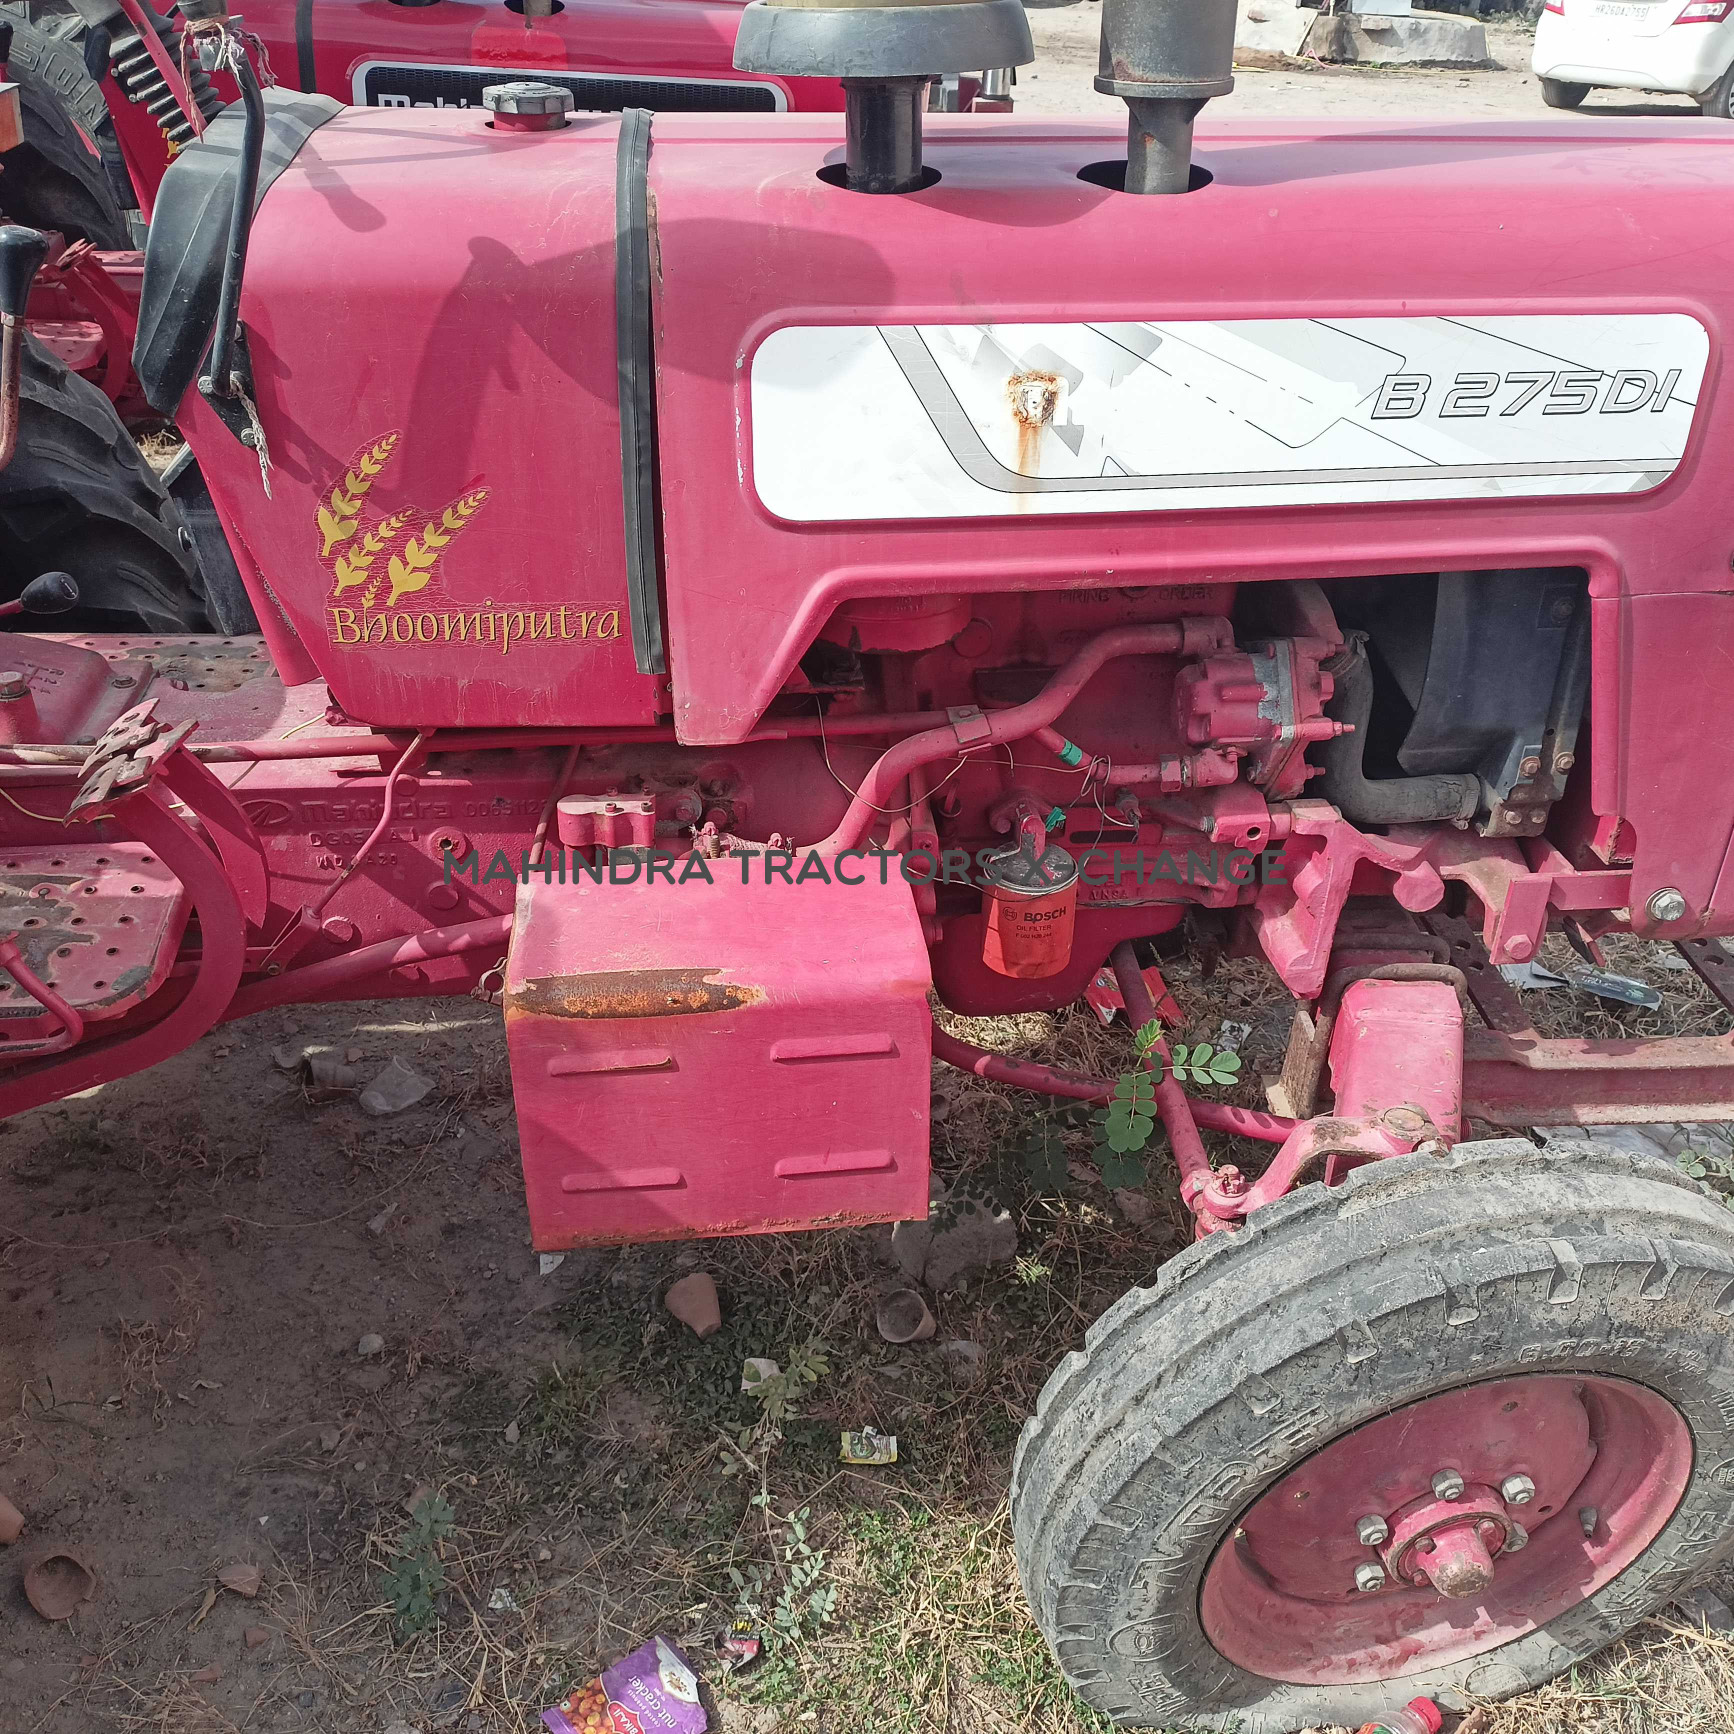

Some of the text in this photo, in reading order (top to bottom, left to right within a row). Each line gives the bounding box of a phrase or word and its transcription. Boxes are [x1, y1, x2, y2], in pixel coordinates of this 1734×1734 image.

[1370, 368, 1682, 420] B 275DI
[327, 596, 623, 655] Bhoomiputra
[1023, 906, 1067, 923] BOSCH
[1028, 924, 1052, 932] FILTER
[628, 1674, 663, 1712] cracker
[611, 1707, 640, 1734] BIKAJI
[657, 1707, 678, 1730] nut
